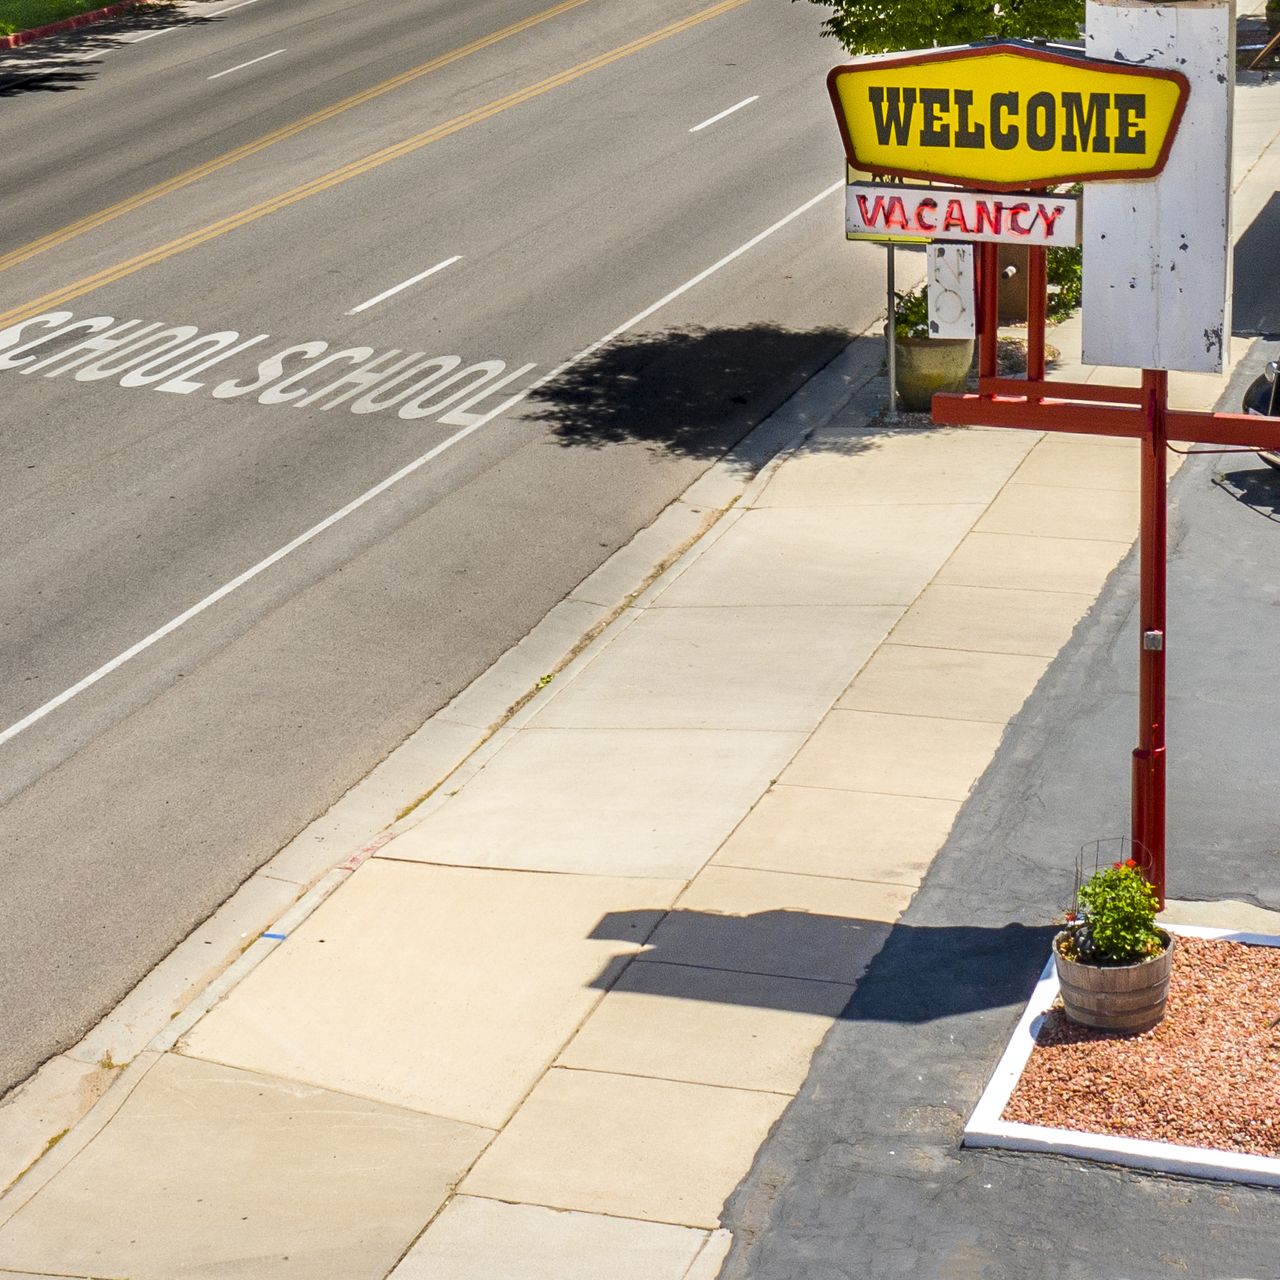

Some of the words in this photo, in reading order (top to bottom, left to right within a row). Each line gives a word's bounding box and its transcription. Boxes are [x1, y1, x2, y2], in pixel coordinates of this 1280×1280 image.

[868, 86, 1147, 155] WELCOME
[856, 194, 1065, 239] VACANCY
[212, 341, 538, 426] SCHOOL
